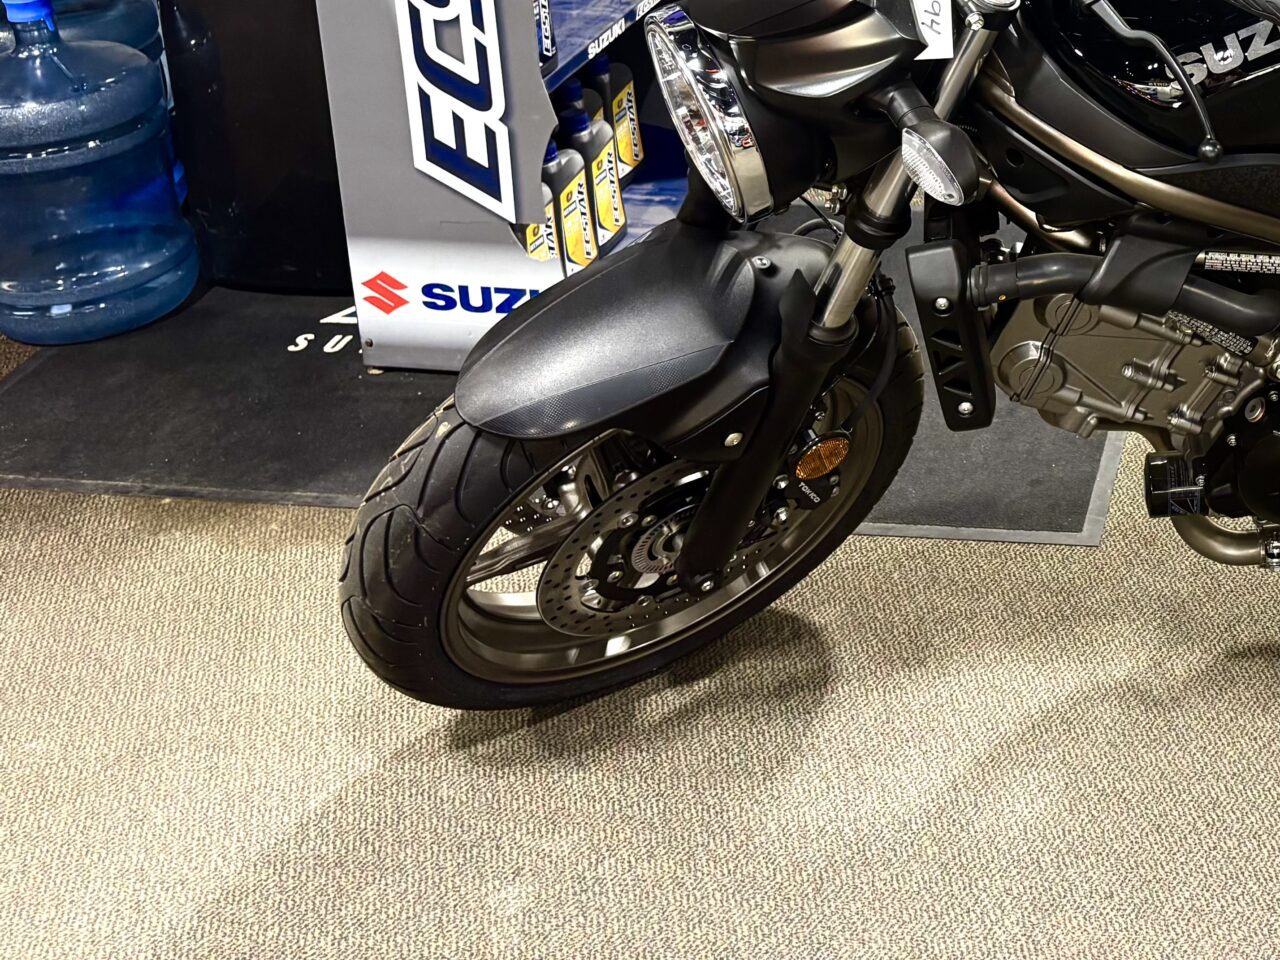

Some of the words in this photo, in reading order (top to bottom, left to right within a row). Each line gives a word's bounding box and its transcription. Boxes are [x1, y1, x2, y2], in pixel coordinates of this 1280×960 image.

[587, 17, 626, 60] SUZUKI
[625, 90, 640, 162] ECSTAR
[606, 151, 620, 227] ECSTAR
[577, 182, 592, 260] ECSTAR
[421, 282, 540, 315] SUZ
[798, 481, 821, 503] TOKICO
